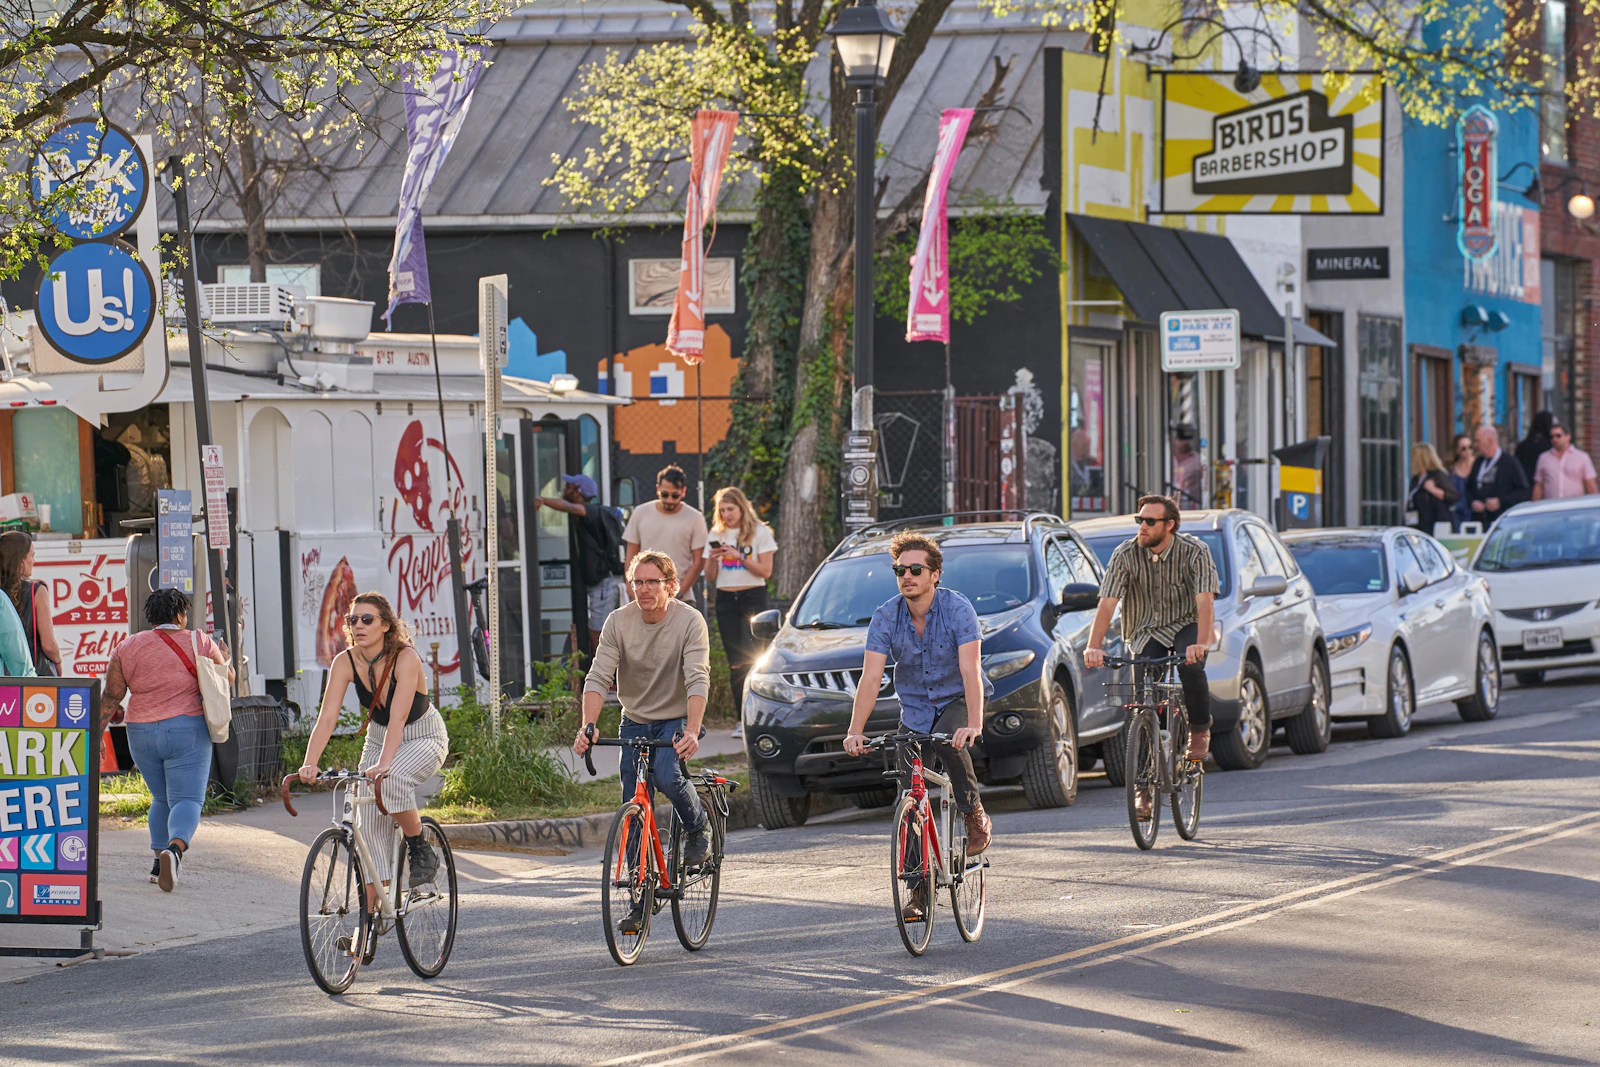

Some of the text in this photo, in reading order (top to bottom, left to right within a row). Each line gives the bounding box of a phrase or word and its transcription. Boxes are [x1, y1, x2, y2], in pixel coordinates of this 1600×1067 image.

[1219, 104, 1303, 150] BIRDS
[1200, 138, 1338, 177] BARBERSHOP
[1465, 143, 1484, 224] YOGA
[1315, 257, 1382, 270] MINERAL
[52, 267, 135, 336] Us!
[1212, 322, 1233, 330] ATX
[386, 351, 395, 365] ST
[407, 351, 431, 366] AUSTIN
[53, 576, 127, 609] POL
[70, 611, 128, 622] PIZZ
[413, 616, 456, 637] PIZZERI
[74, 629, 109, 661] Eat
[75, 663, 105, 673] WE CAN
[37, 885, 78, 897] Premier
